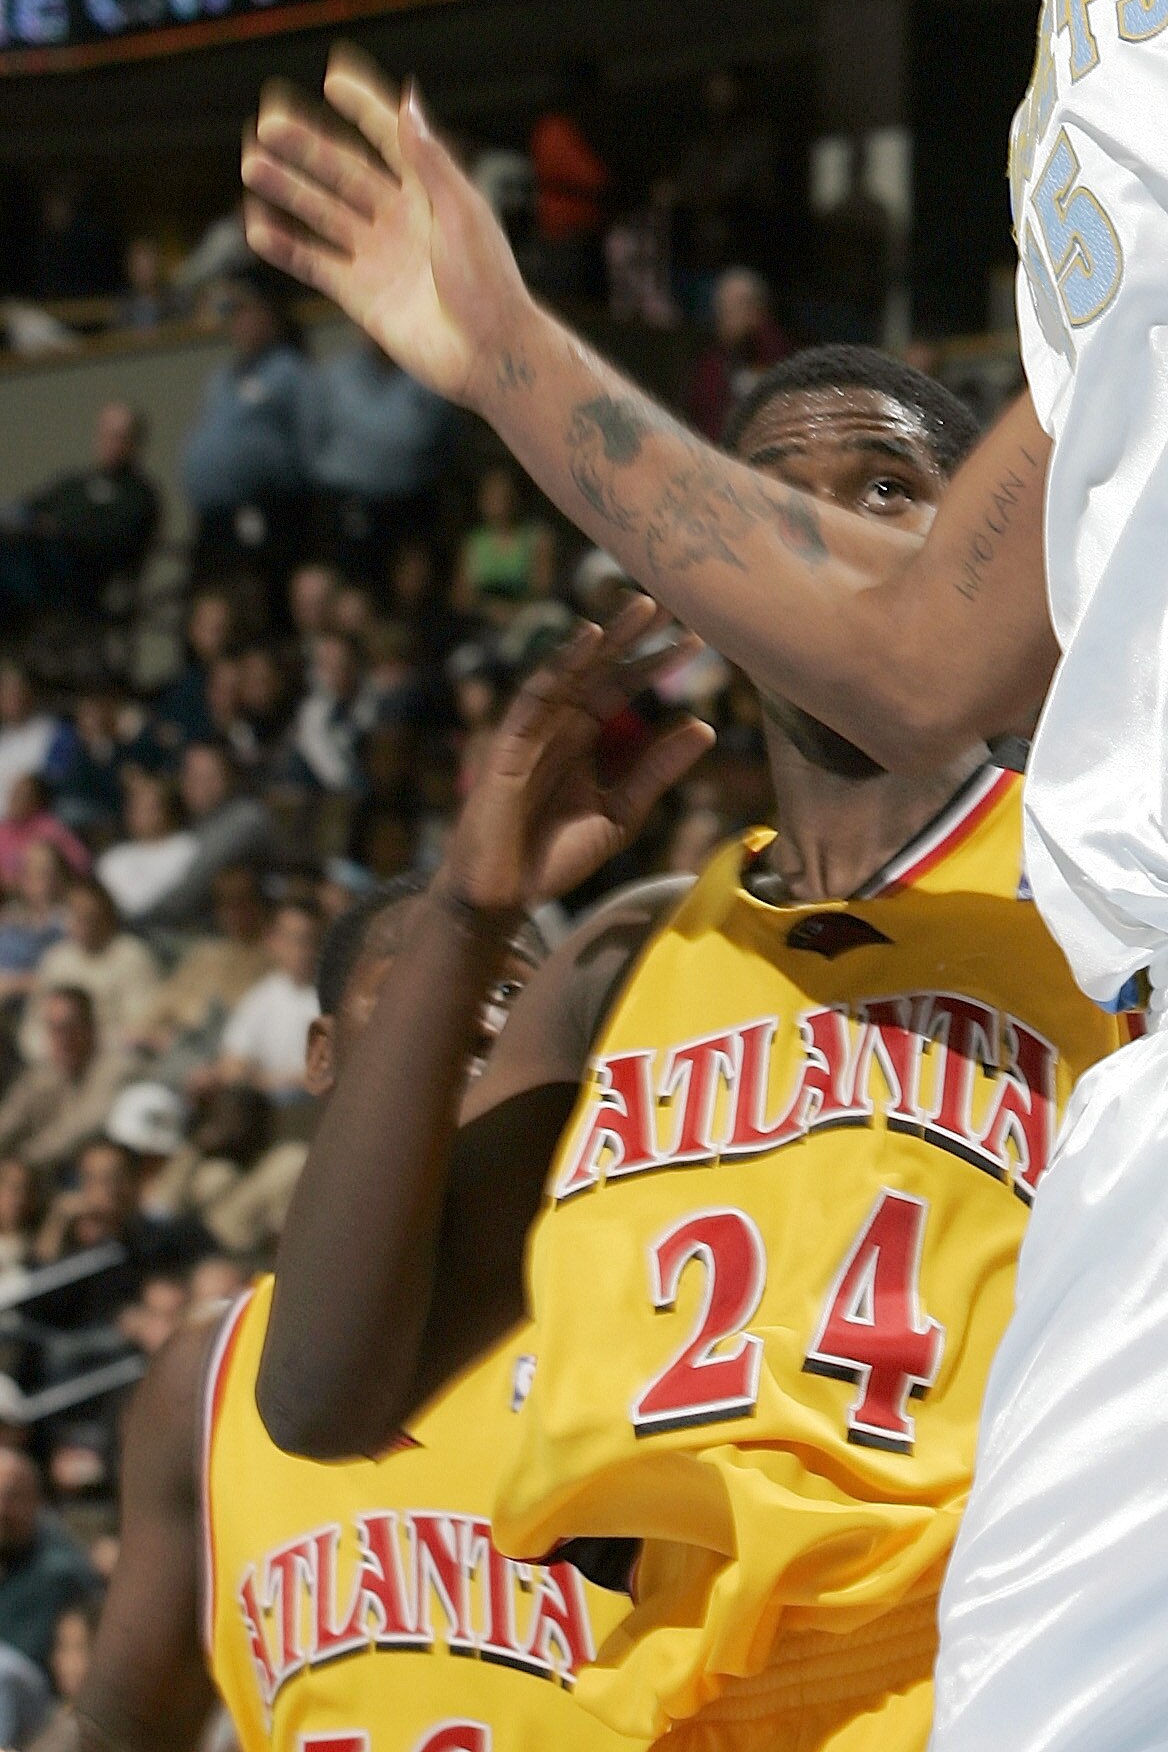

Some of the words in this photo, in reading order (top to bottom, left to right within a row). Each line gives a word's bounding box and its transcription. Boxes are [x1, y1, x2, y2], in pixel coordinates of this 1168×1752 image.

[985, 467, 1026, 538] CAN
[550, 991, 1060, 1210] ATLANTA
[632, 1186, 946, 1456] 24
[239, 1509, 598, 1708] ATLANTA
